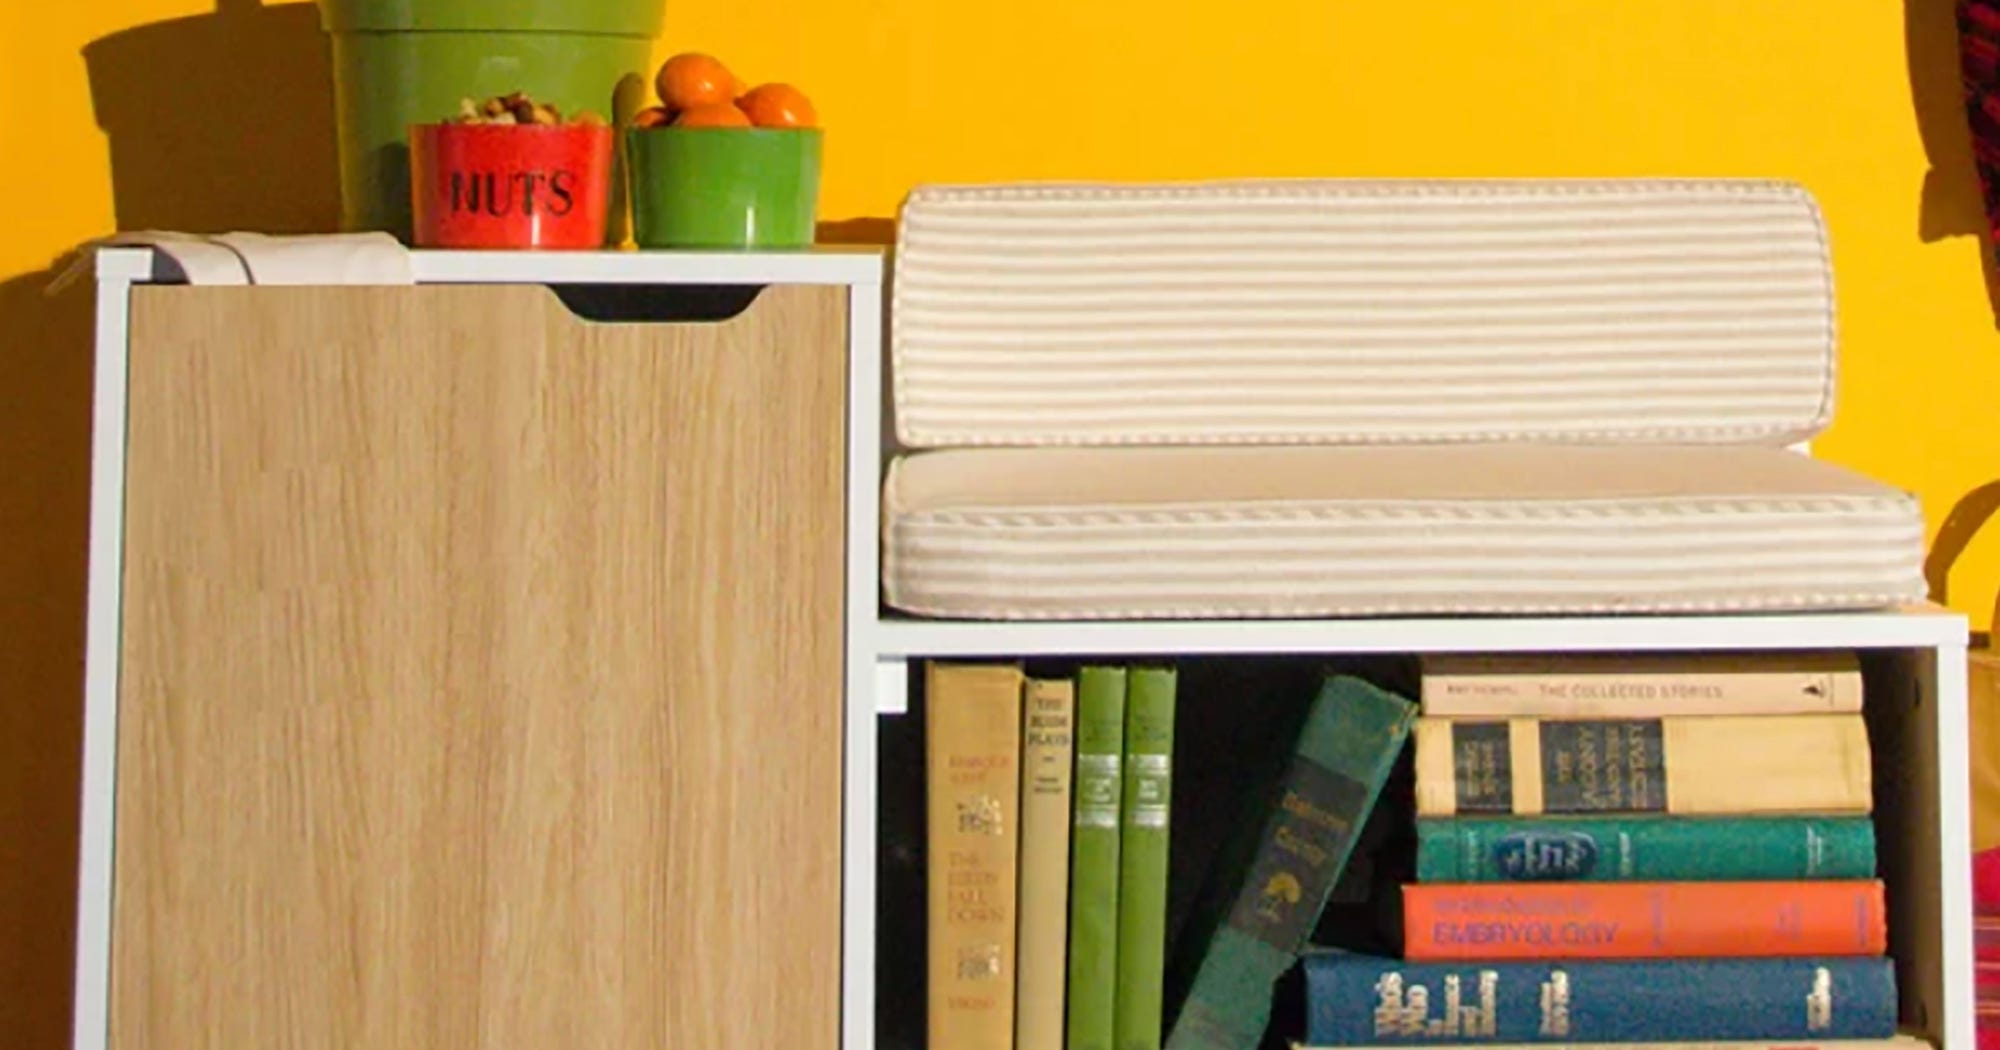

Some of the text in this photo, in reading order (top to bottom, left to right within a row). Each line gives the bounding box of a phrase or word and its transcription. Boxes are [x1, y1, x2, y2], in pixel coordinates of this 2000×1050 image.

[451, 169, 574, 217] NUTS
[1539, 683, 1724, 699] THE COLLECTED STORIES
[1433, 921, 1620, 945] EMBRYOLOGY
